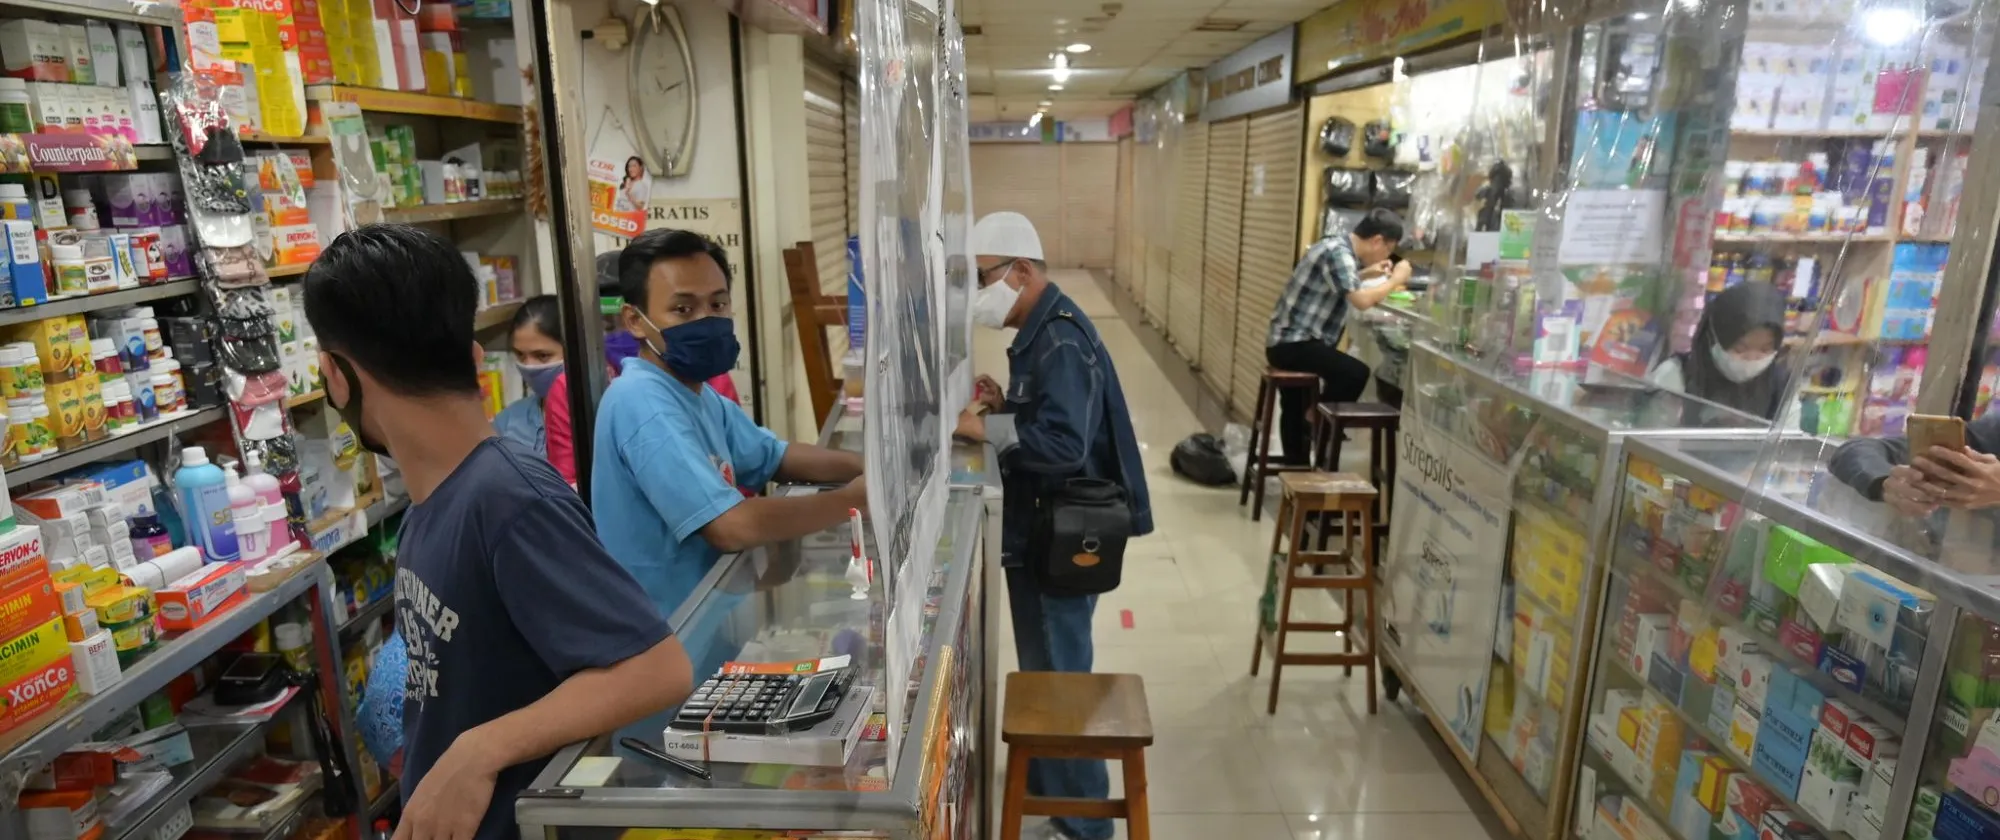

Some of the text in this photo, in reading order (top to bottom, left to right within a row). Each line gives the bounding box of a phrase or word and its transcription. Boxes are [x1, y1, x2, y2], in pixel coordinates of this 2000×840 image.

[30, 143, 105, 165] Counterpain
[592, 211, 639, 232] LOSED
[1402, 432, 1453, 493] Strepsils
[313, 527, 341, 551] empra
[88, 641, 107, 655] BEFIT
[8, 667, 68, 707] XonCe
